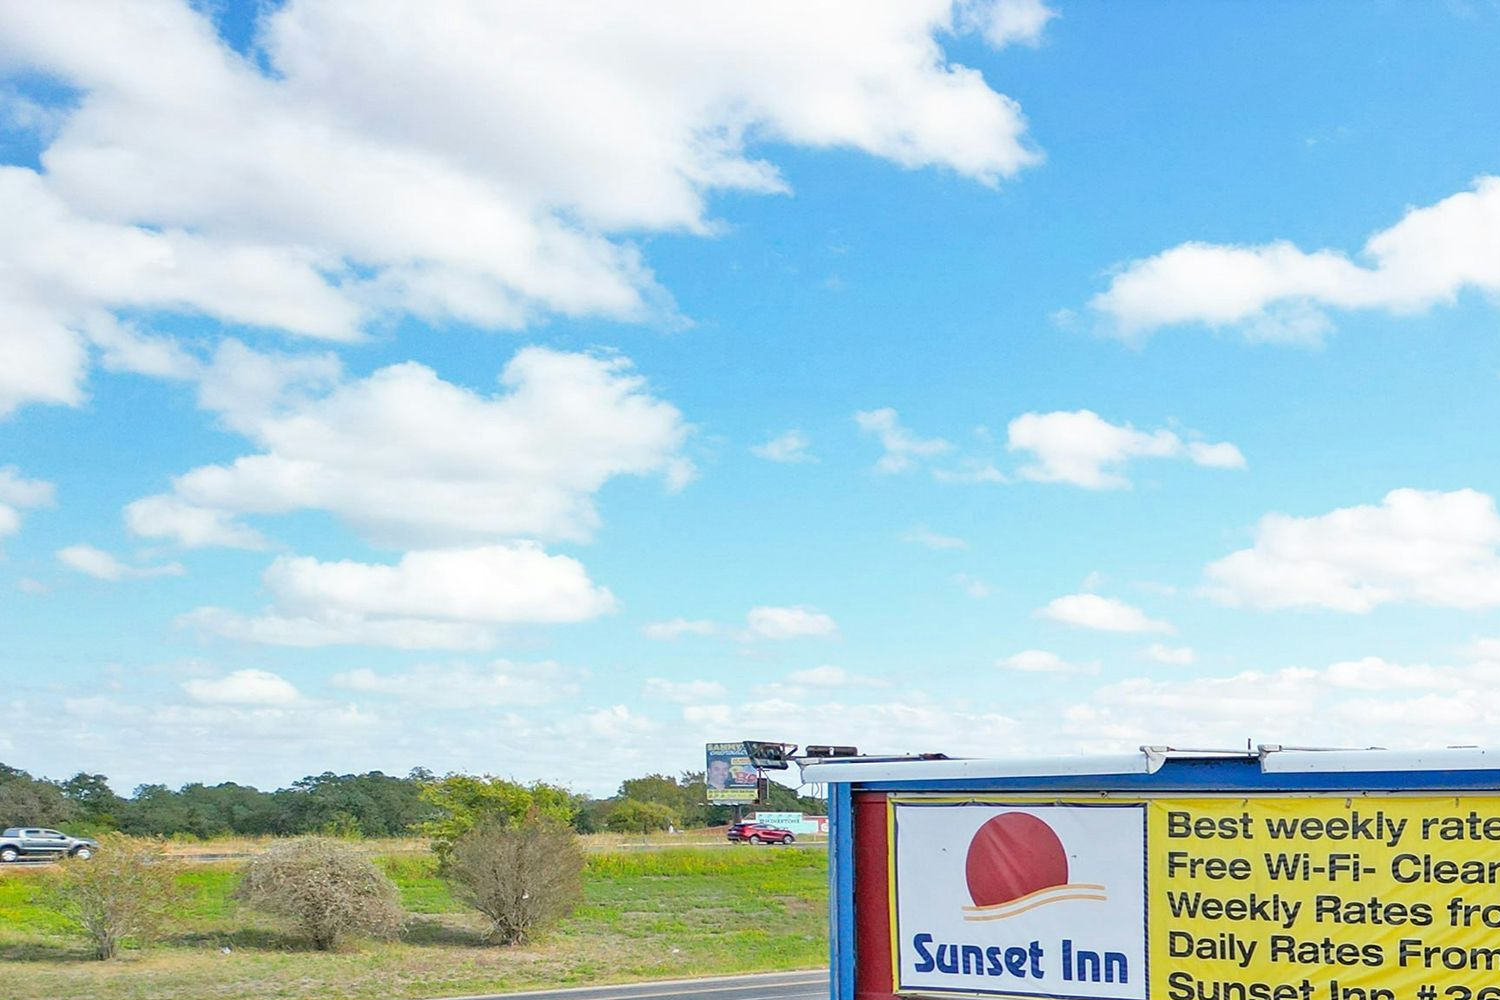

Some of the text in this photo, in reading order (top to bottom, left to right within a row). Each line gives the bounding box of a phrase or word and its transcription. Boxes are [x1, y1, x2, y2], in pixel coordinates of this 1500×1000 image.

[1167, 811, 1254, 840] Best
[1265, 811, 1408, 848] weekly
[1168, 851, 1252, 881] Free
[1167, 891, 1302, 929] Weekly
[1315, 895, 1433, 927] Rates
[912, 932, 1129, 984] Sunset Inn
[1168, 931, 1256, 968] Daily
[1270, 935, 1384, 967] Rates
